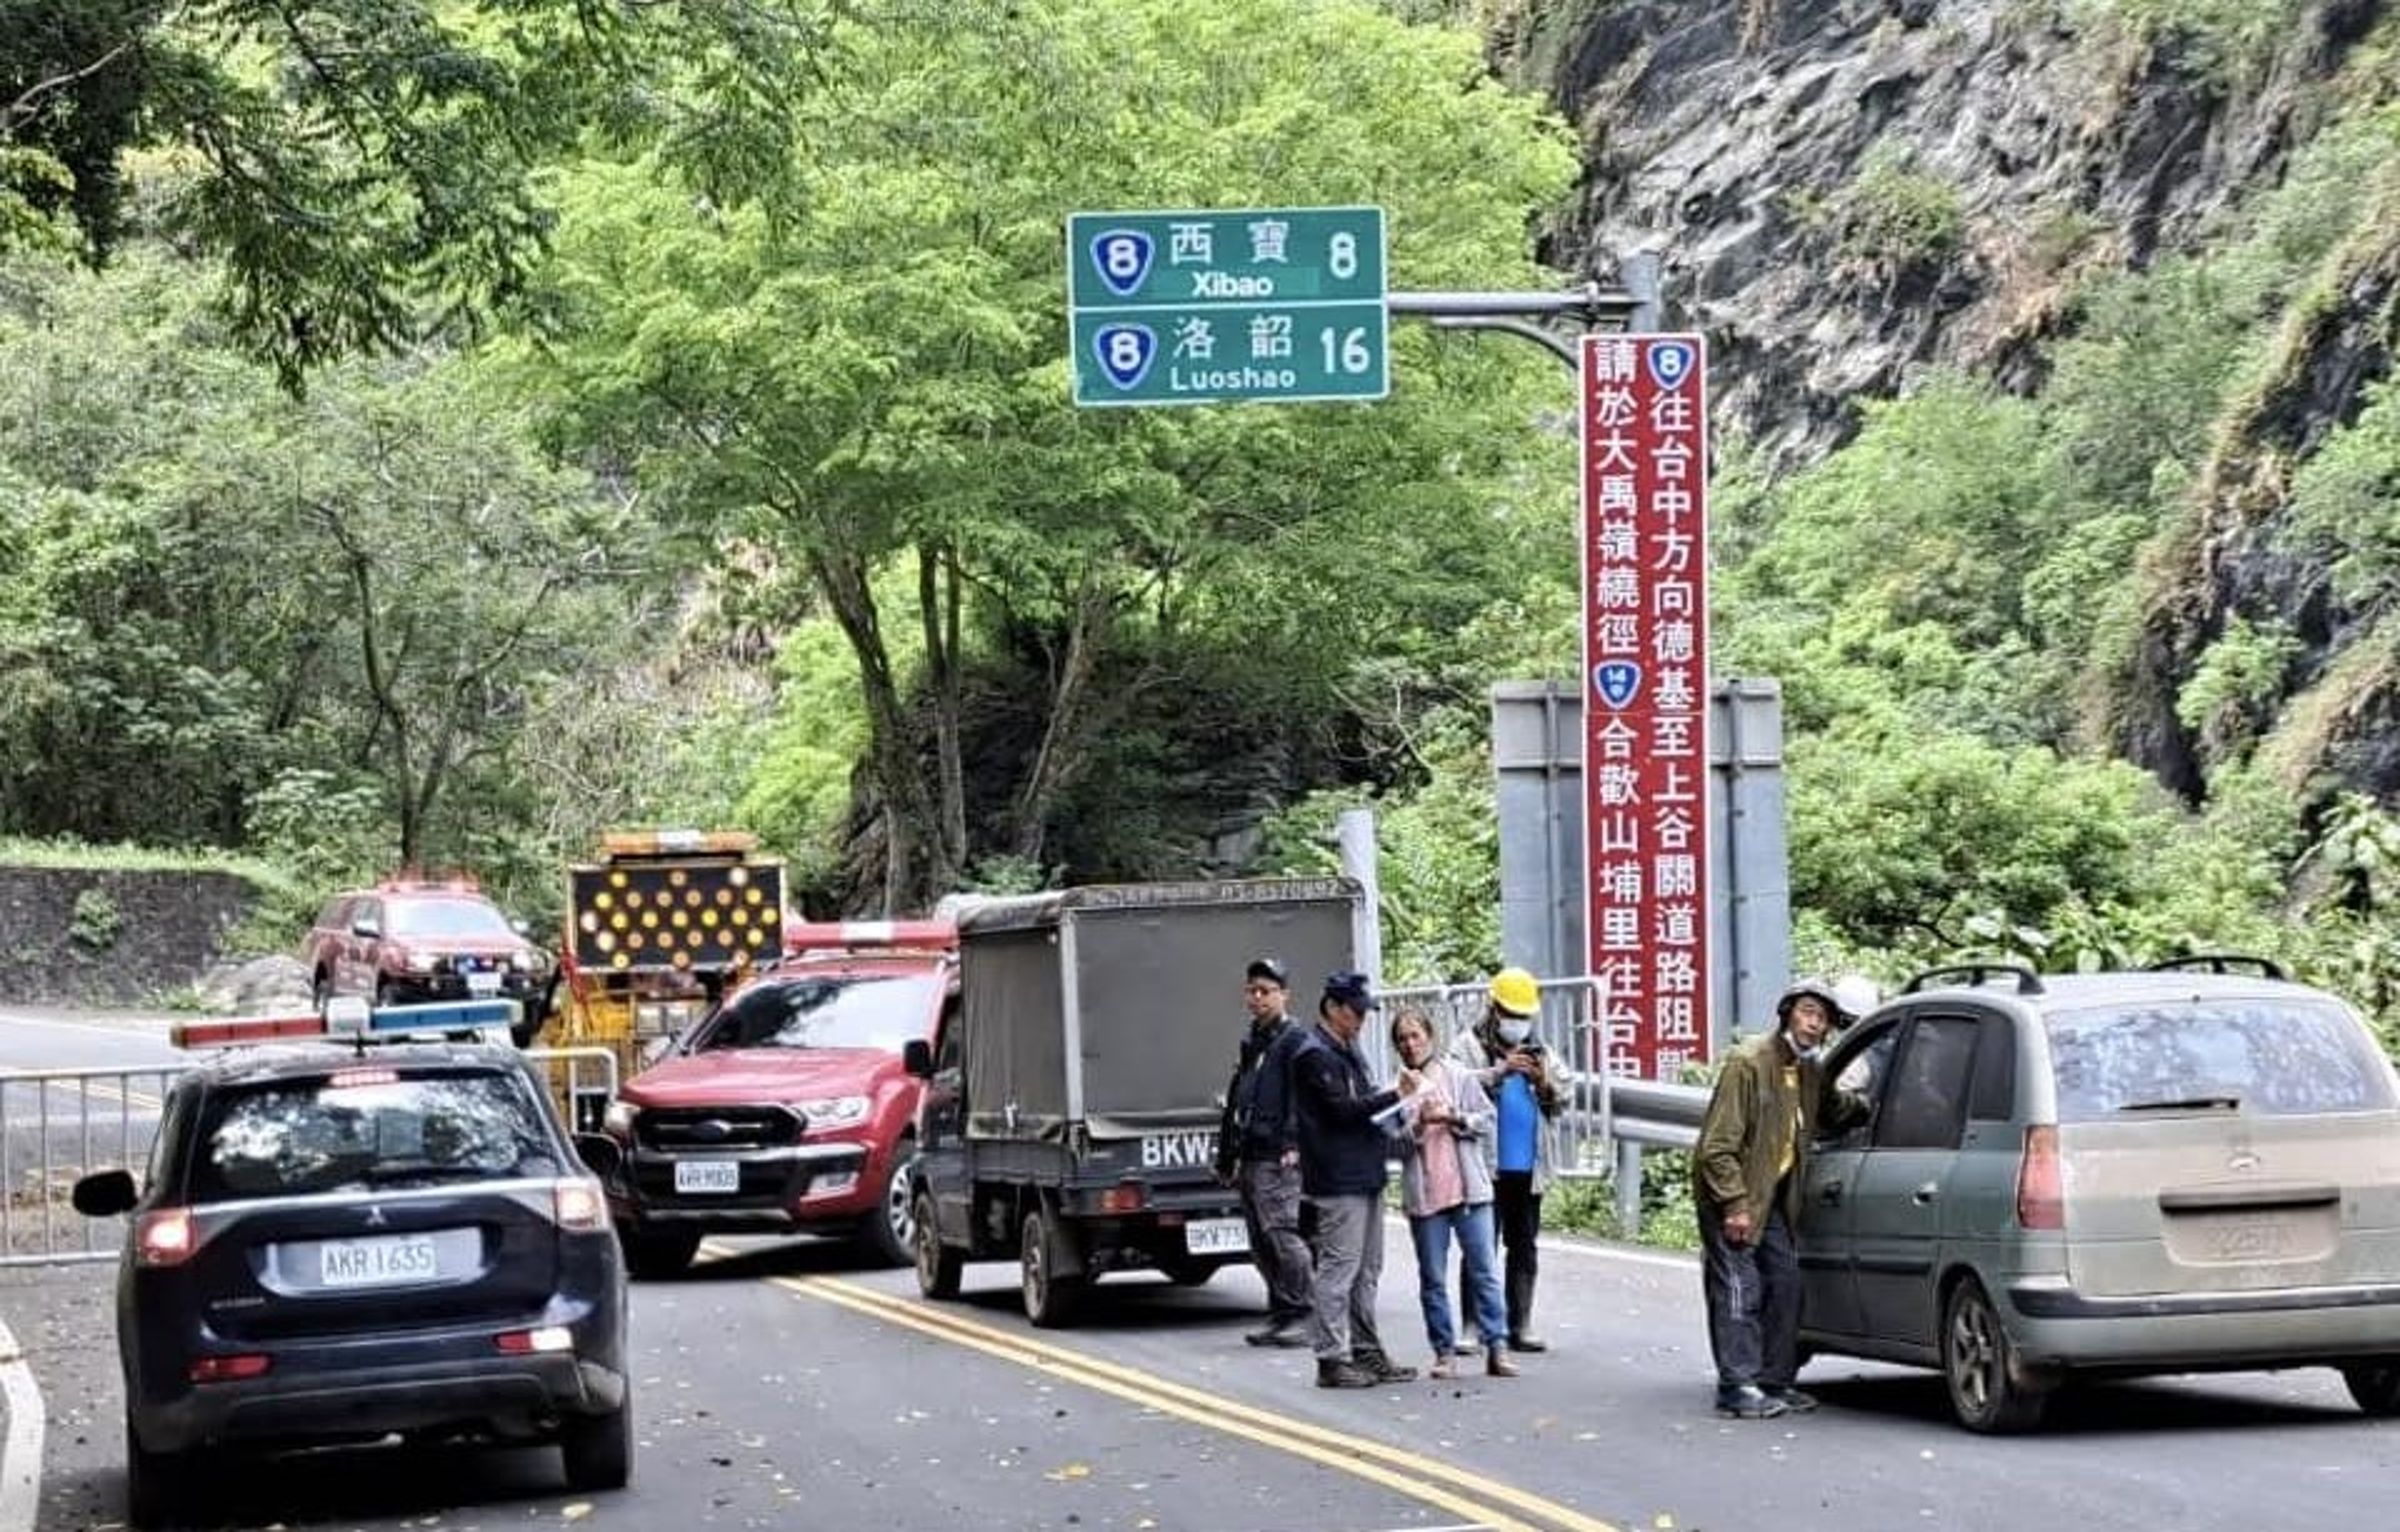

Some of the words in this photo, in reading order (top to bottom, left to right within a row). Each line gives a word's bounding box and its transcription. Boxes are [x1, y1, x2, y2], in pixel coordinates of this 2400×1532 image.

[1108, 238, 1139, 277] 8
[1169, 218, 1289, 265] 西寶
[1329, 231, 1358, 279] 8
[1191, 271, 1274, 297] Xibao
[1110, 331, 1141, 371] 8
[1173, 314, 1293, 360] 洛韶
[1319, 326, 1370, 374] 16
[1658, 348, 1682, 378] 8
[1170, 366, 1296, 392] Luoshao
